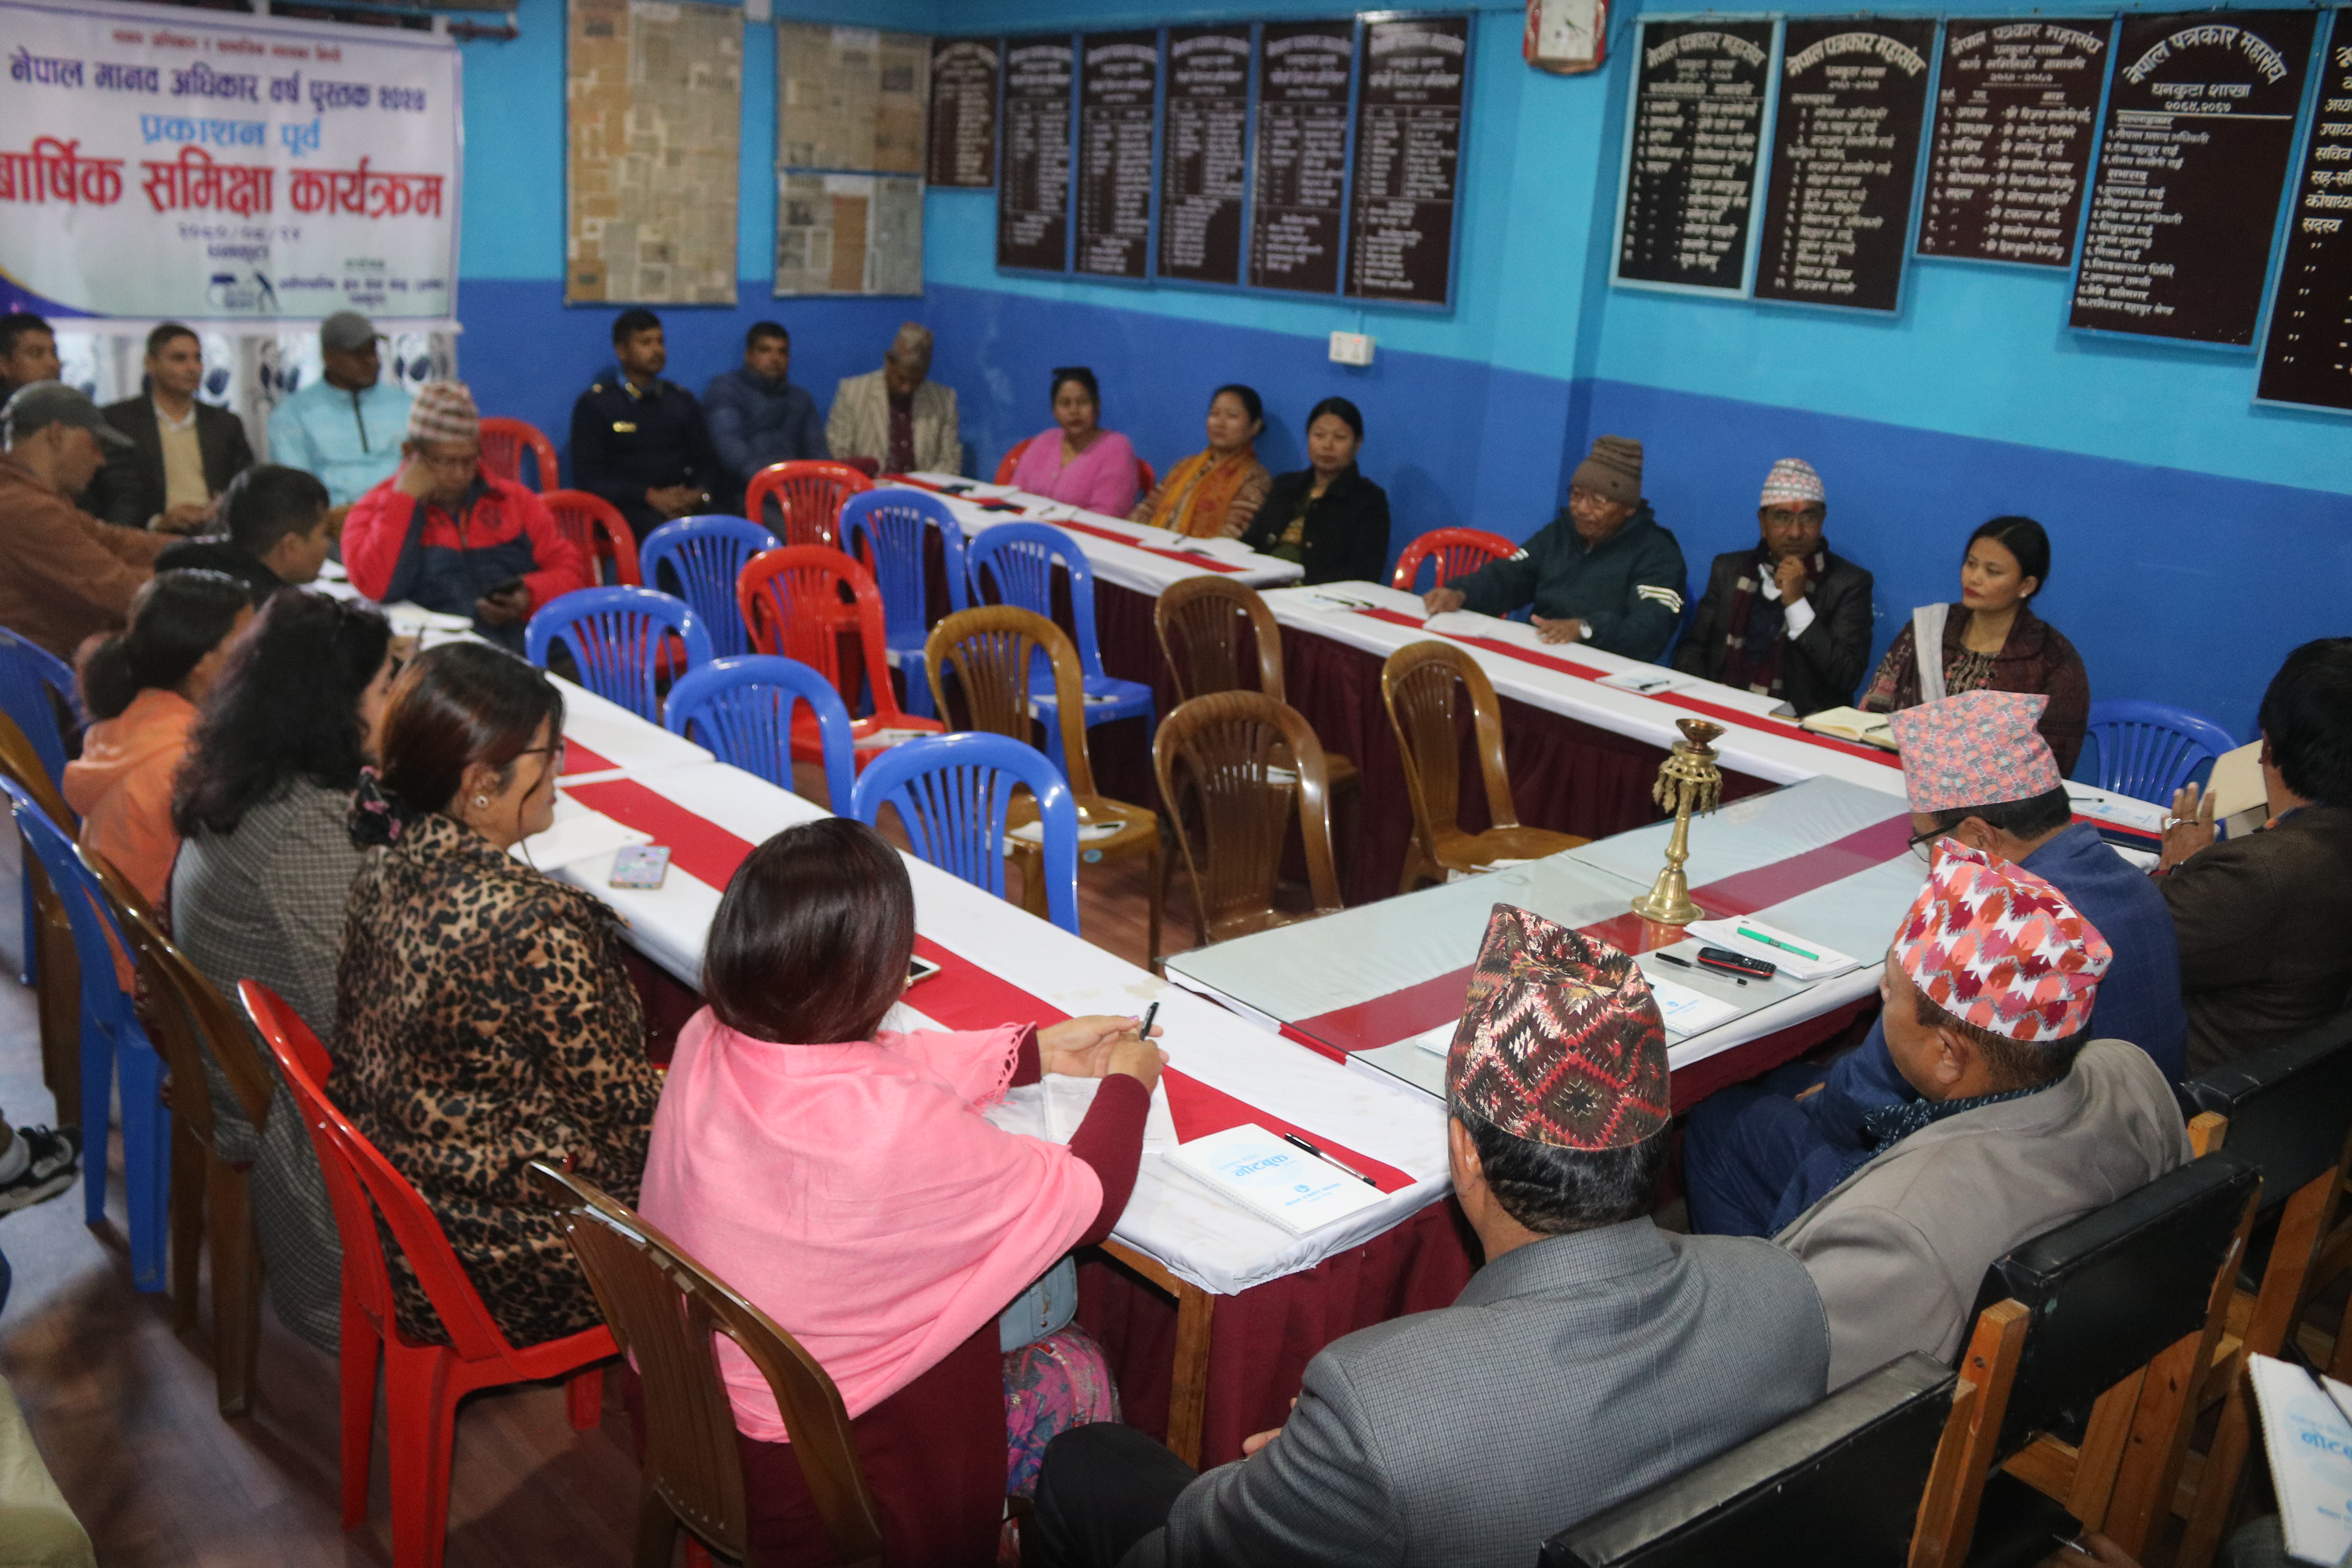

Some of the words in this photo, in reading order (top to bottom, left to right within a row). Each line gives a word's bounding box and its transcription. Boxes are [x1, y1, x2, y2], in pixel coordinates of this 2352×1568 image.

[1786, 40, 1825, 77] नेपाल
[1874, 34, 1927, 77] महासंघ
[1951, 31, 1987, 57] नेपाल
[1992, 23, 2042, 40] पत्रकार
[2045, 24, 2104, 55] महासंघ
[2032, 44, 2065, 56] शाखा
[2122, 40, 2171, 85] नेपाल
[2169, 24, 2240, 51] पत्रकार
[2240, 30, 2288, 85] महासंघ
[9, 44, 84, 87] नेपाल
[94, 62, 159, 94] मानव
[170, 62, 259, 102] अधिकार
[269, 71, 300, 102] वर्ष
[2151, 82, 2206, 100] धनकुटा
[2207, 83, 2252, 99] शाखा
[139, 115, 268, 146] प्रकाशन
[280, 118, 321, 158] पूर्व
[139, 143, 275, 219] समिक्षा
[289, 155, 445, 219] कार्यक्रम
[2302, 218, 2343, 234] सदस्य
[1231, 1154, 1289, 1177] नोटबुक
